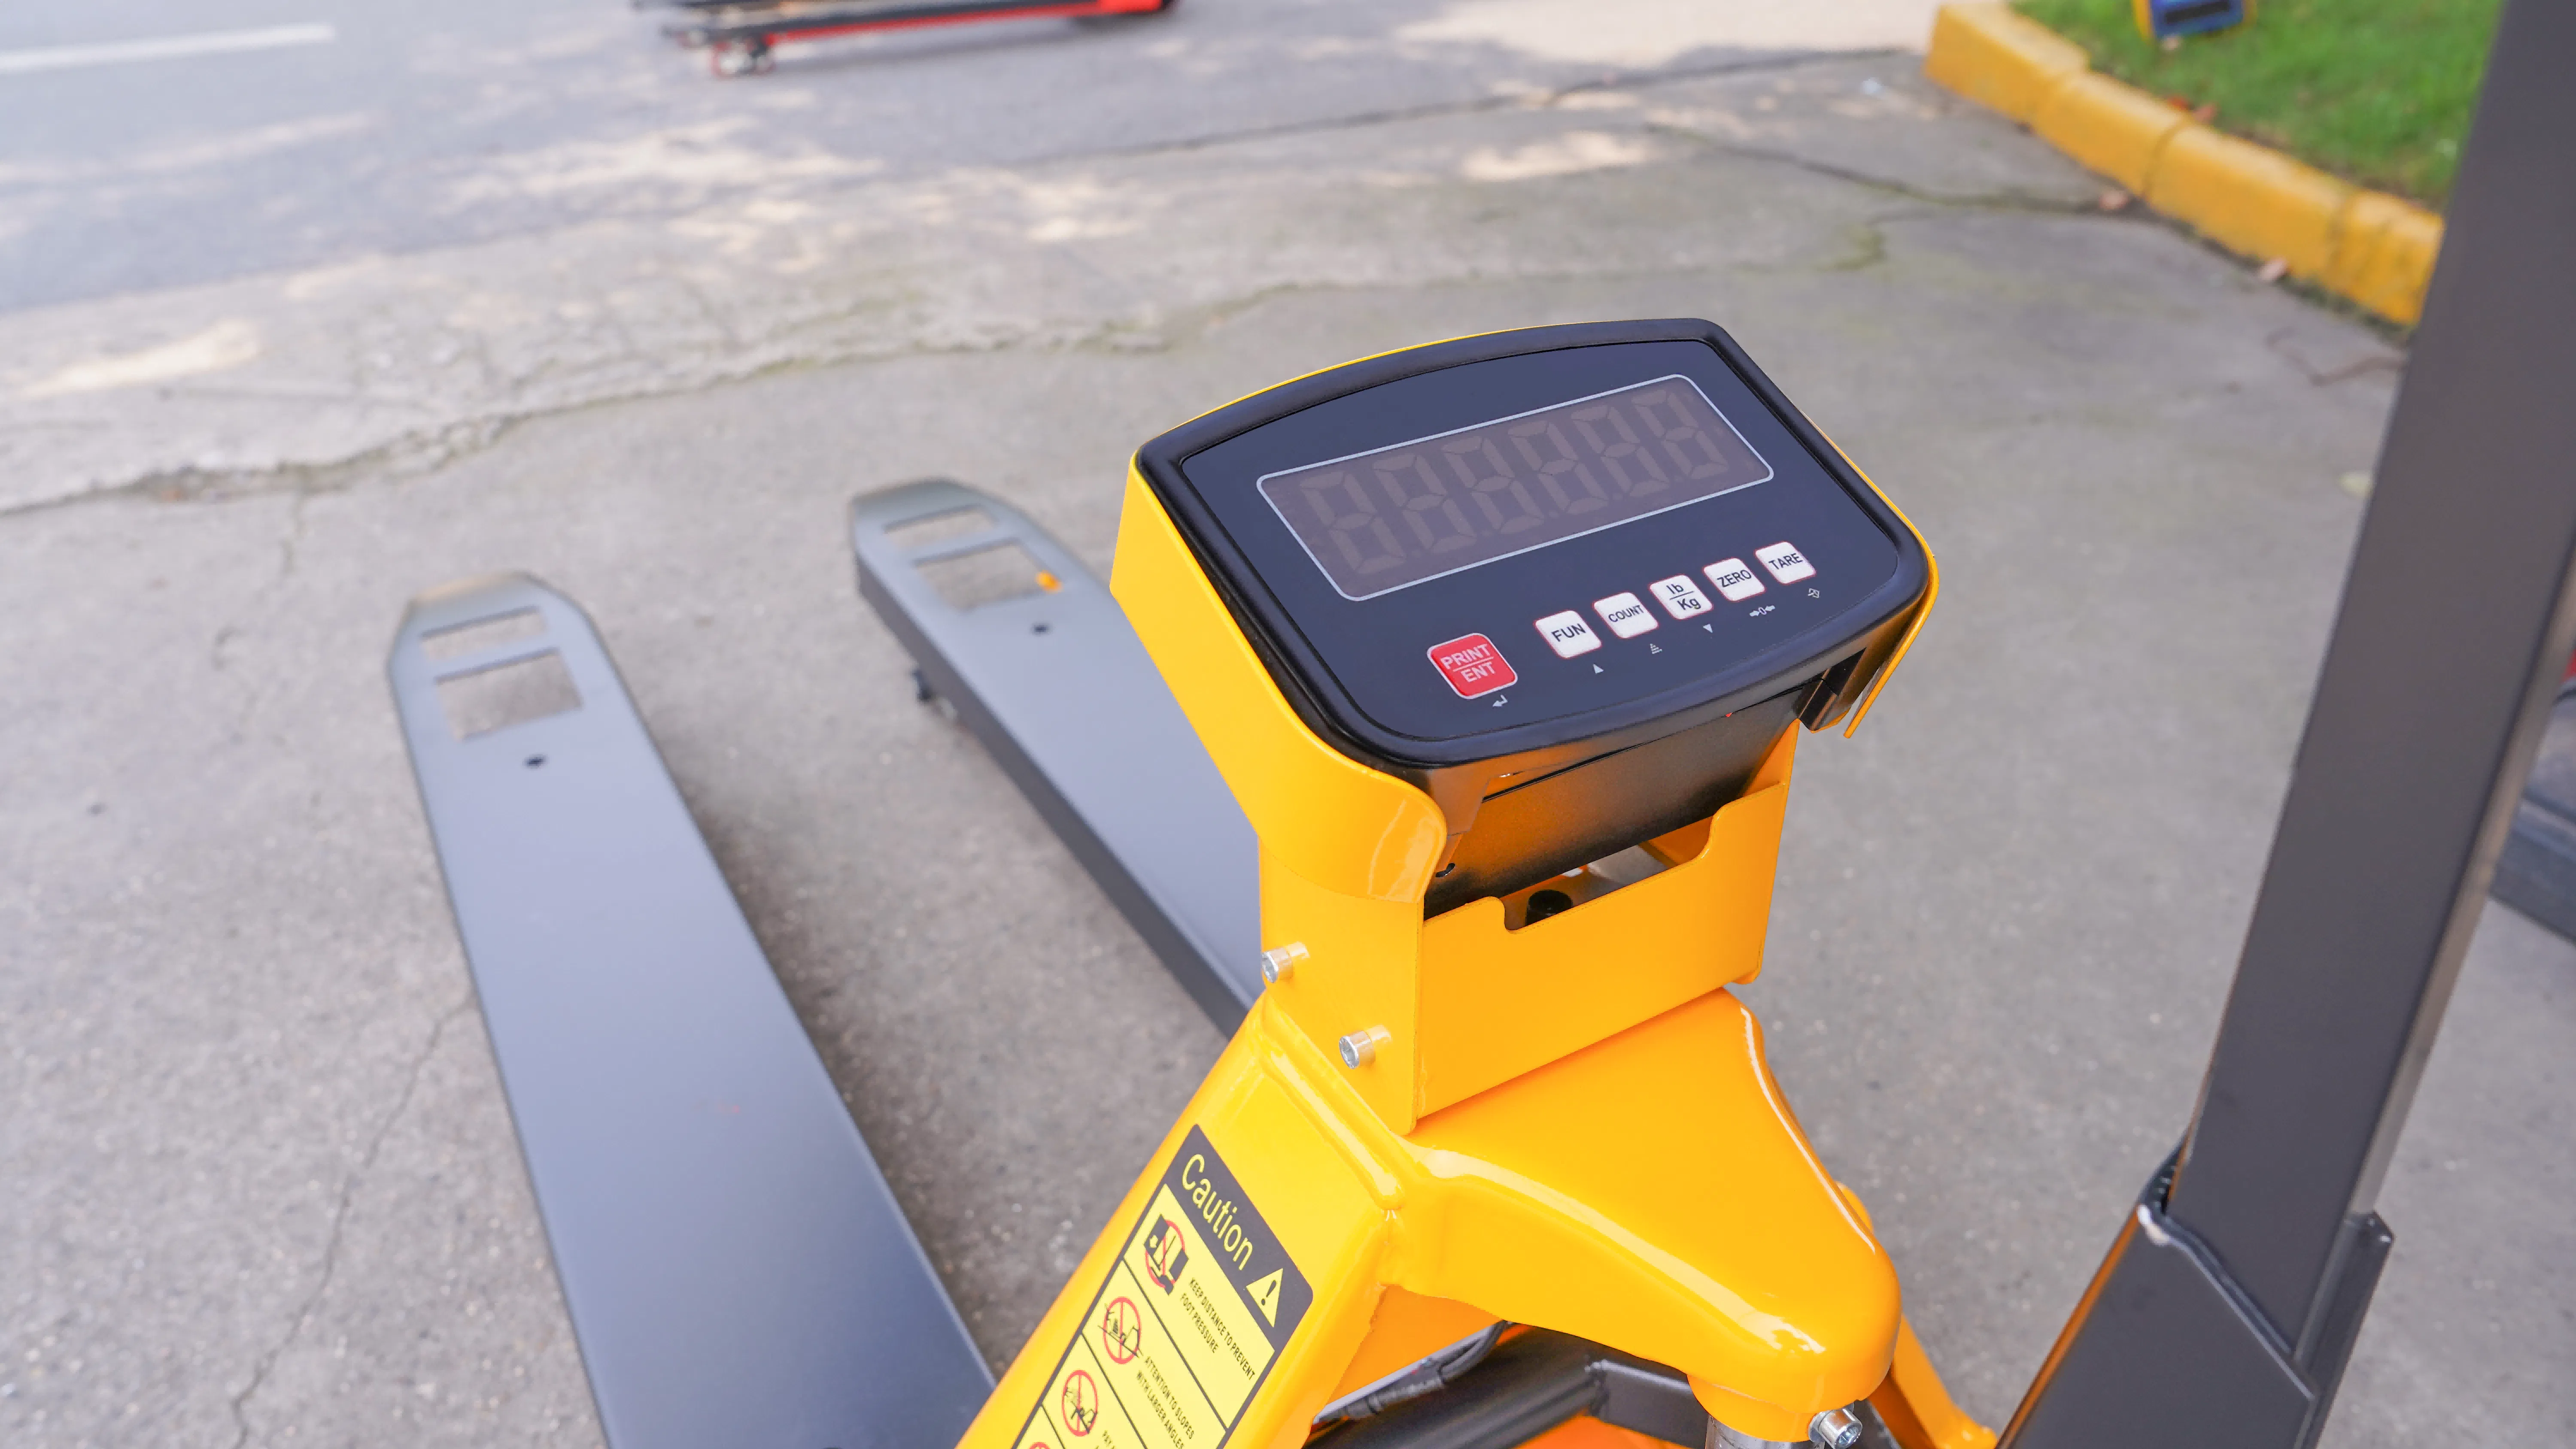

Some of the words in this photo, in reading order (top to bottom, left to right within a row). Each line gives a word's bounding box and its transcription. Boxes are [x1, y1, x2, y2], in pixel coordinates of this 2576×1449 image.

[1768, 553, 1803, 570] TARE
[1717, 569, 1752, 588] ZERO
[1608, 605, 1645, 622] COUNT
[1677, 597, 1701, 610] Kg
[1551, 623, 1586, 642] FUN
[1440, 644, 1491, 669] PRINT
[1461, 661, 1496, 682] ENT
[1182, 1154, 1253, 1270] Caution
[1180, 1292, 1195, 1315] FOOT
[1192, 1312, 1219, 1353] PRESSURE
[1189, 1277, 1204, 1298] KEEP
[1200, 1296, 1226, 1336] DISTANCE
[1224, 1331, 1233, 1346] TO
[1230, 1342, 1255, 1380] PREVENT
[1144, 1356, 1171, 1400] ATTENTION
[1169, 1396, 1177, 1410] TO
[1175, 1407, 1194, 1439] SLOPES
[1147, 1389, 1166, 1422] LARGER
[1163, 1419, 1184, 1449] ANGLES
